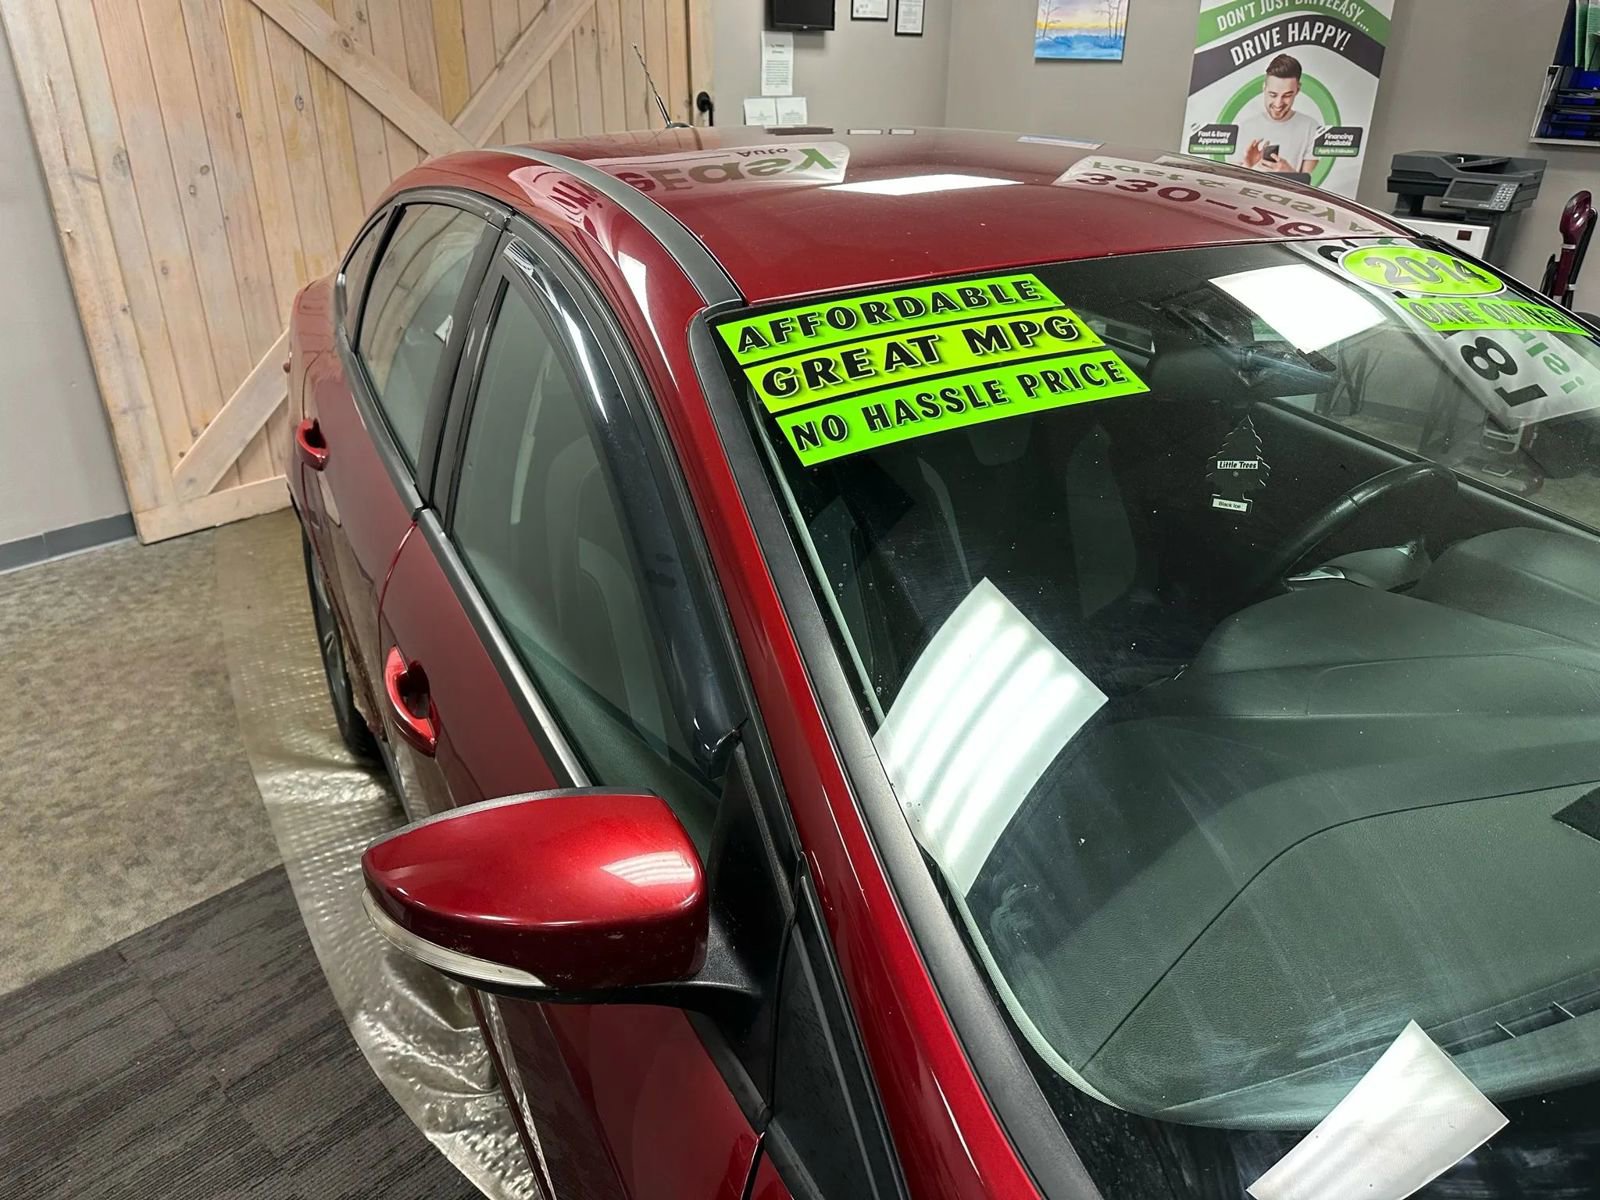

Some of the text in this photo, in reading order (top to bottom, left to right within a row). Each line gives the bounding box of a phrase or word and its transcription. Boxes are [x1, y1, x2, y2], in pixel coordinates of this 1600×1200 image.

[1217, 2, 1255, 31] DON'T
[1230, 21, 1352, 66] DRIVE HAPPY!
[1198, 137, 1228, 145] Approvals
[1217, 131, 1231, 139] Easy
[1324, 133, 1354, 141] Financing
[1363, 256, 1491, 284] 2014
[736, 278, 1044, 354] AFFORDABLE
[1409, 302, 1488, 325] ONE
[761, 315, 1079, 398] GREAT MPG
[790, 360, 1129, 452] NO HASSLE PRICE
